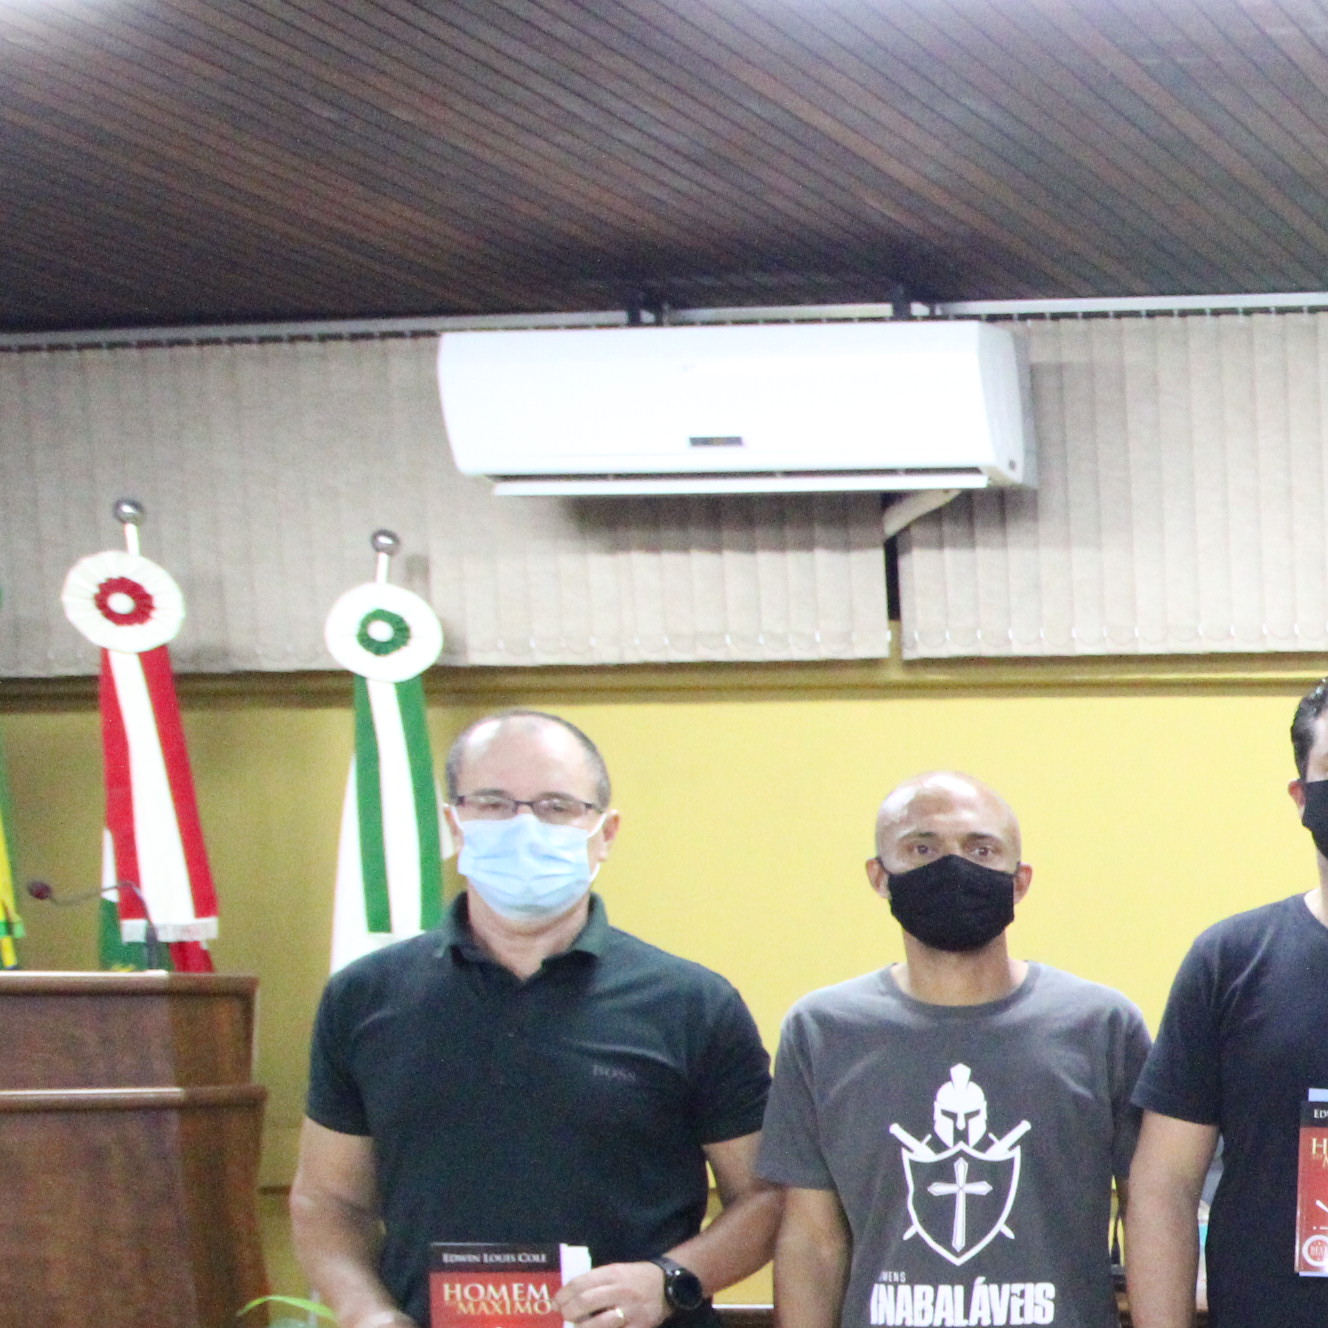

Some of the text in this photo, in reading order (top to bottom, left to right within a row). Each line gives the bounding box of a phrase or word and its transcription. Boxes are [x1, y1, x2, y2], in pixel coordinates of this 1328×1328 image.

[442, 1252, 546, 1263] EDWIN LOUIS COLE
[443, 1282, 551, 1303] HOMEM
[869, 1275, 1056, 1328] INABALÁVEIS
